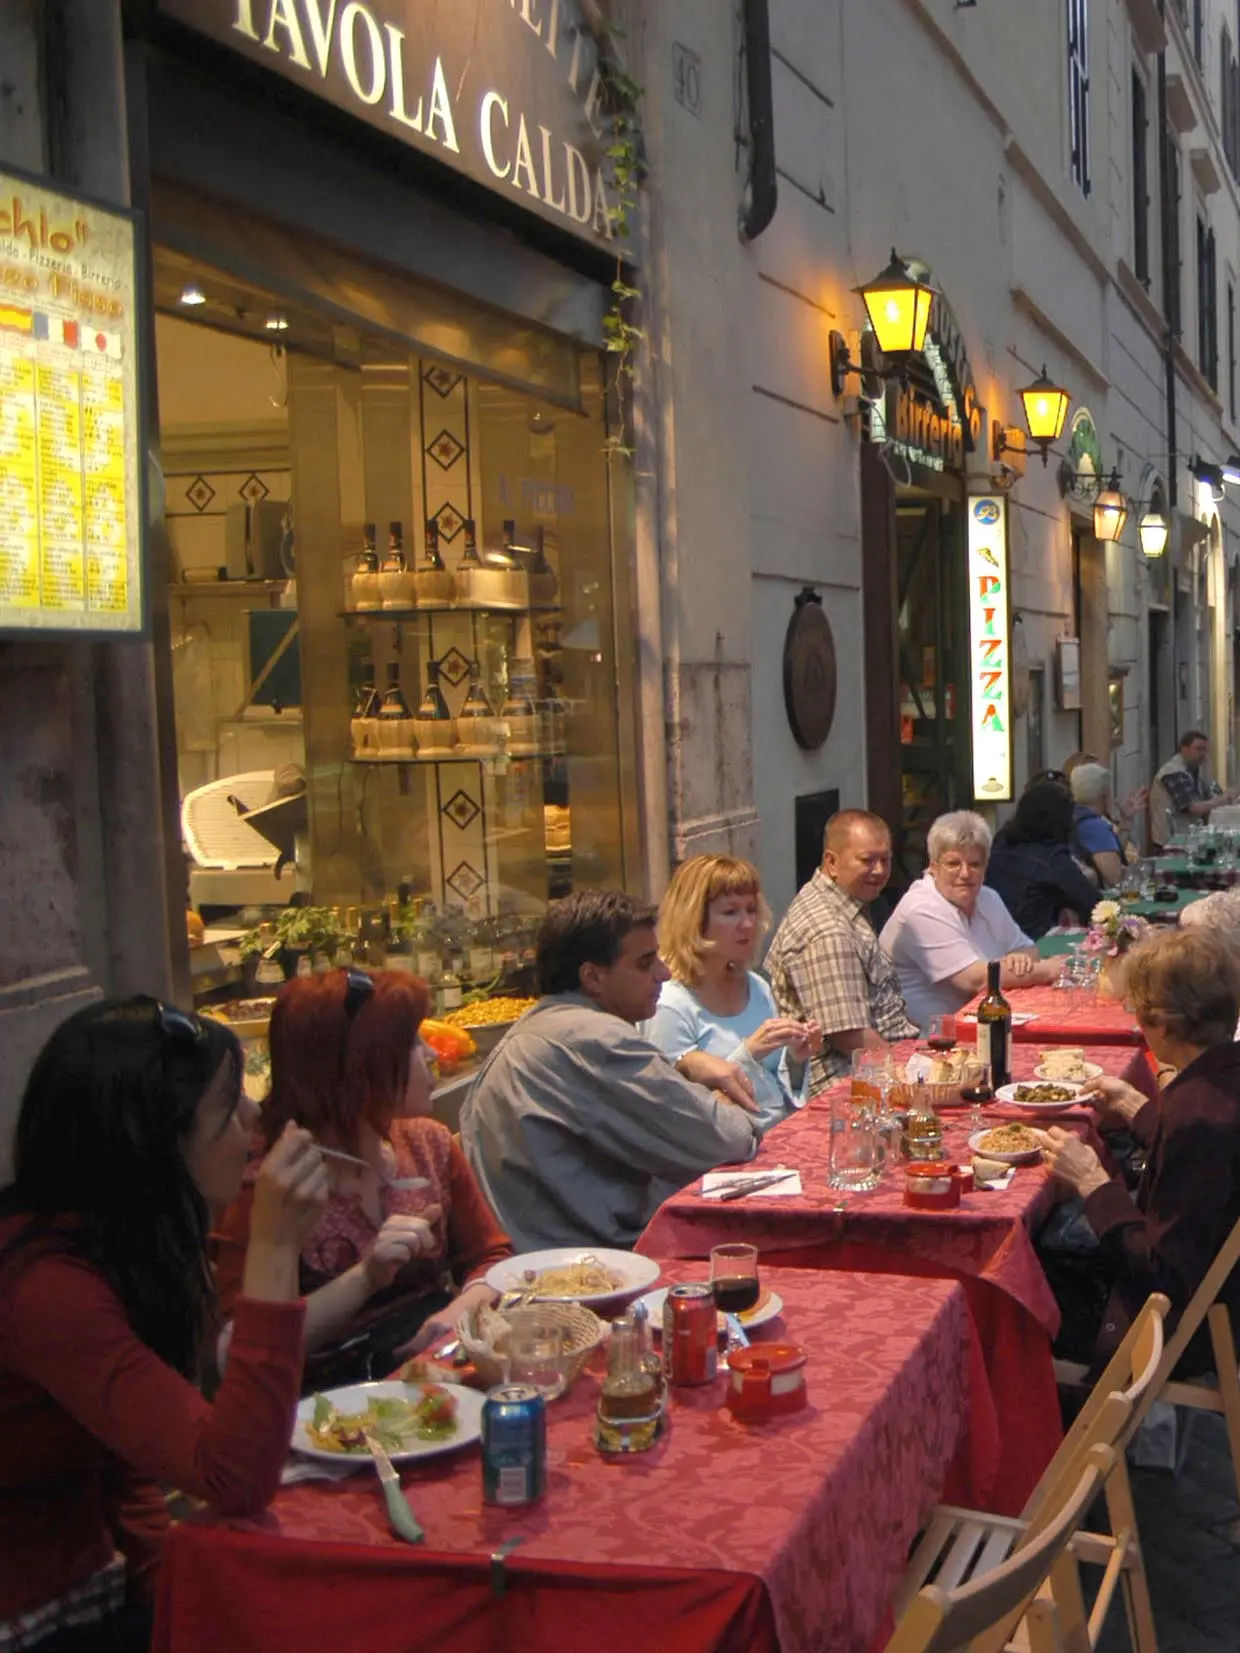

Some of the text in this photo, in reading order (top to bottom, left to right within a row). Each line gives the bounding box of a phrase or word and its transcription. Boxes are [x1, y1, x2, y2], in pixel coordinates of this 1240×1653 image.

[480, 91, 614, 240] CALDA
[80, 262, 122, 290] Birreria
[977, 575, 1005, 733] PIZZA
